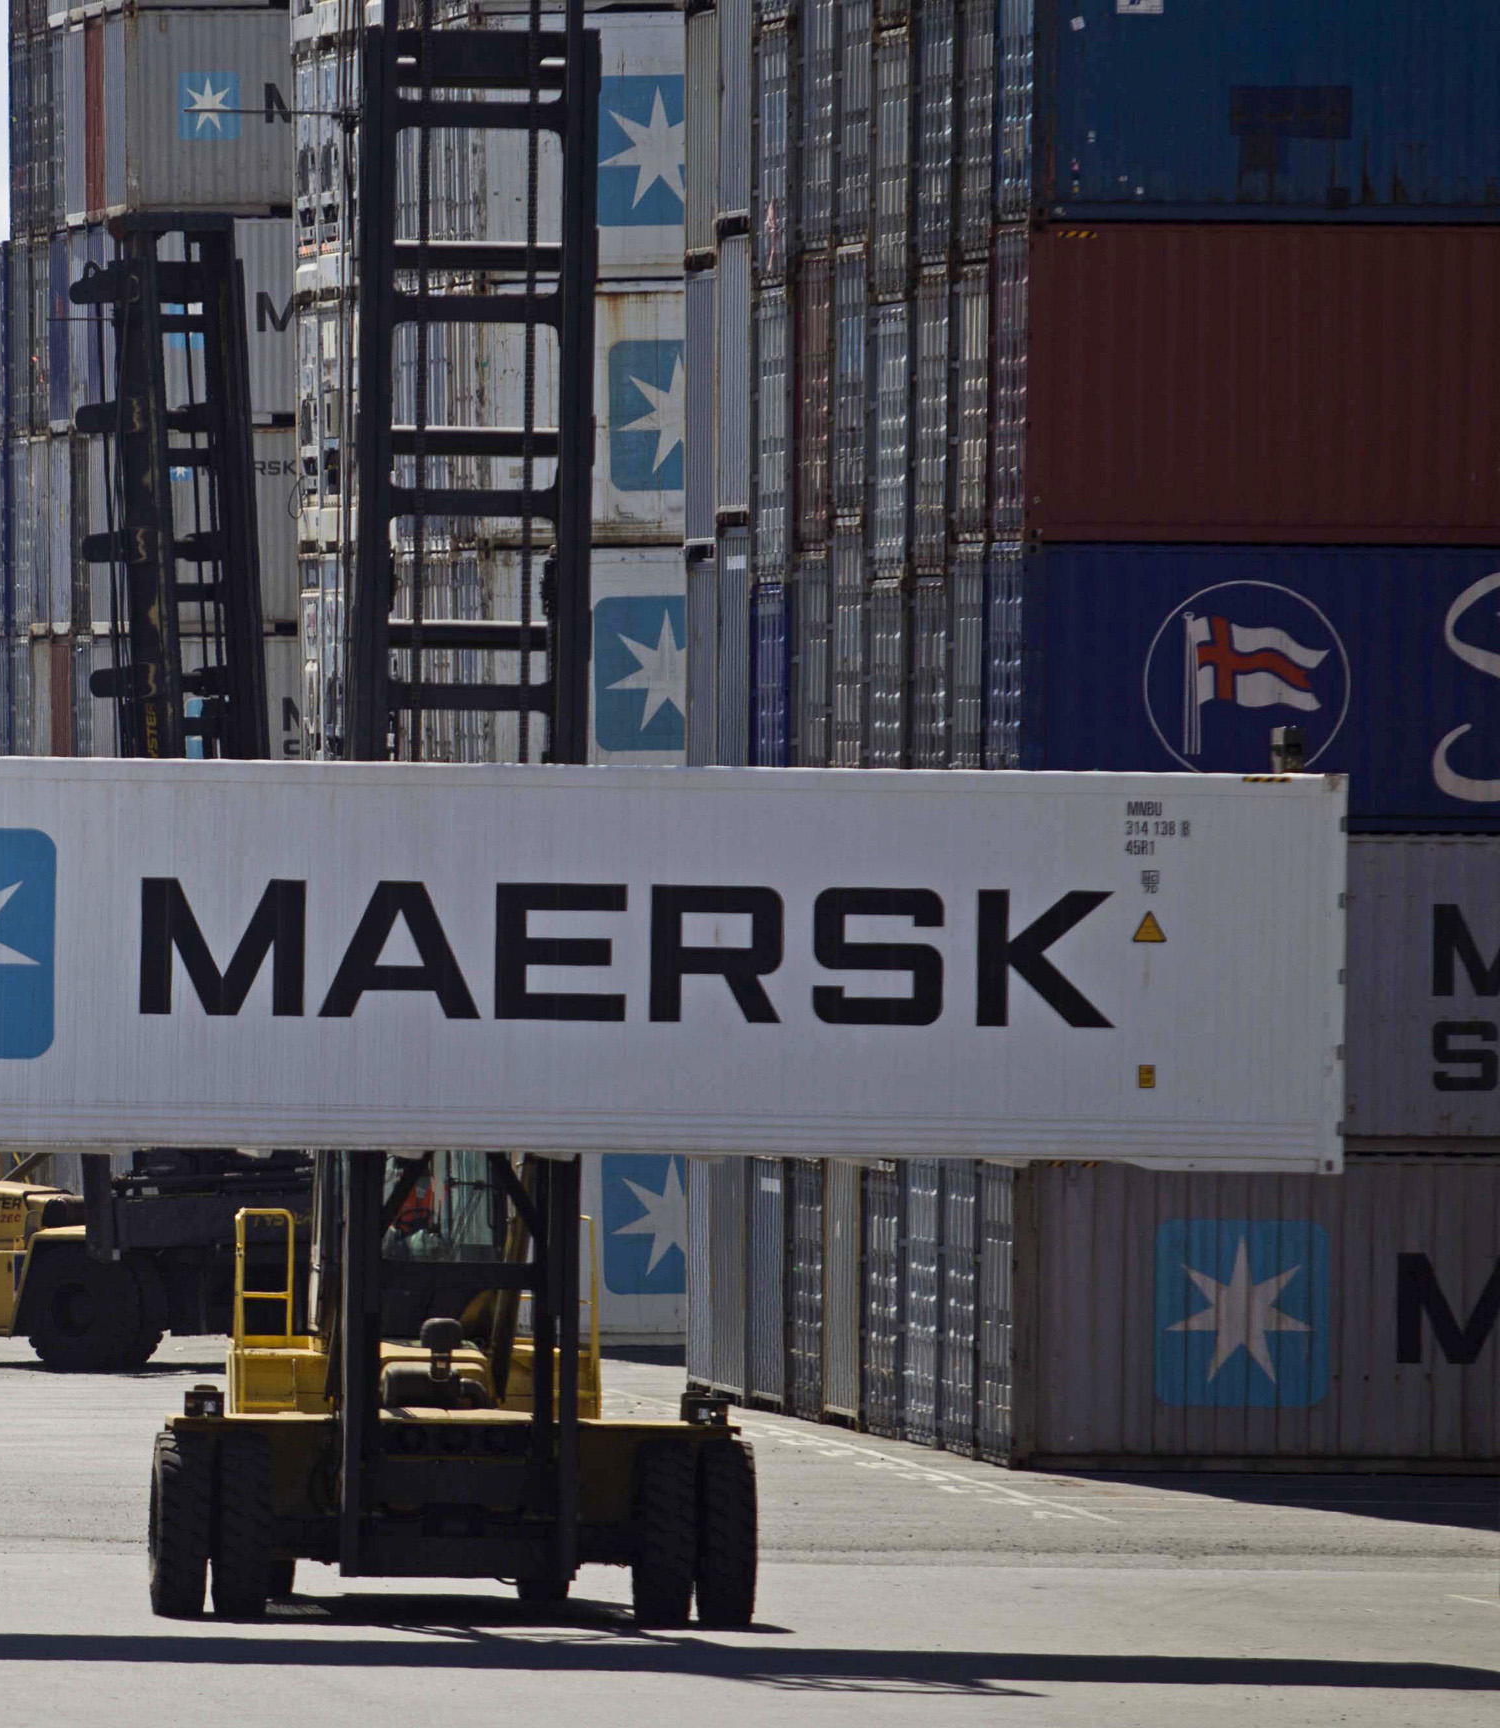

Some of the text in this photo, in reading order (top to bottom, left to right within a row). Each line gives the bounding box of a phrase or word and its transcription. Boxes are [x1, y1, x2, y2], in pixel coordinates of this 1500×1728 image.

[1126, 801, 1163, 816] MNBU
[1125, 820, 1148, 836] 314
[1154, 820, 1176, 836] 138
[1125, 840, 1155, 855] 45R1
[140, 875, 1115, 1029] MAERSK
